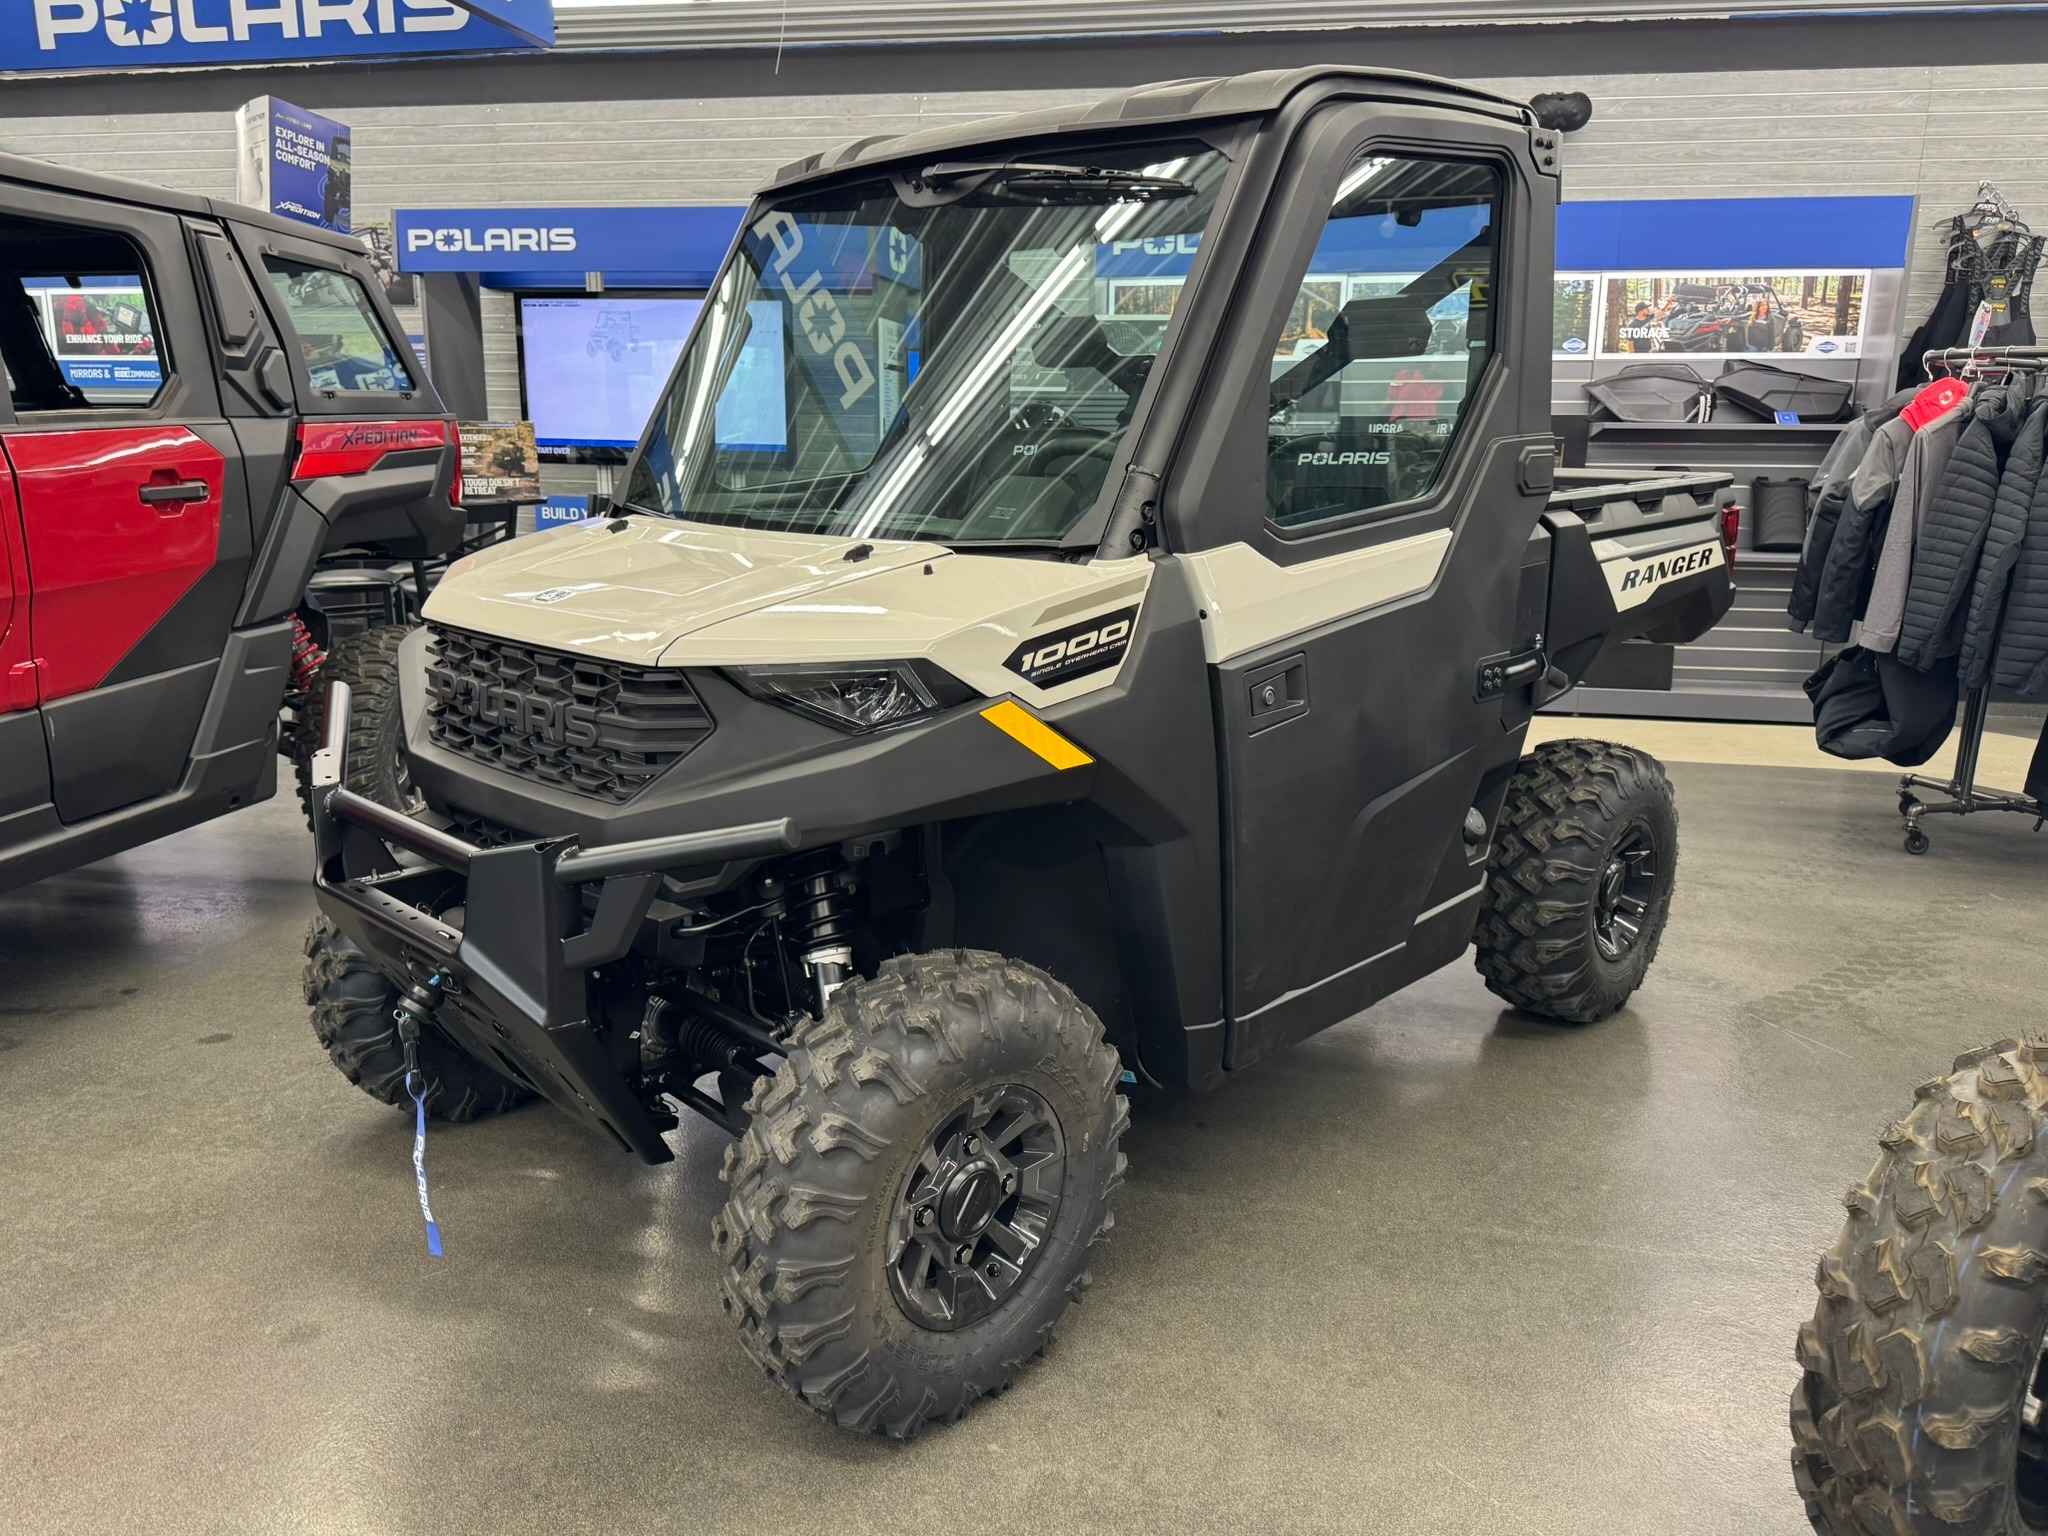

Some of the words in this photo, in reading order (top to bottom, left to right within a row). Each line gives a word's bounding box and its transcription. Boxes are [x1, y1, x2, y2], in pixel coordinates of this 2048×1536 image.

[38, 0, 470, 50] POLARIS
[275, 126, 315, 149] EXPLORE
[316, 140, 325, 152] IN
[275, 138, 331, 166] ALL-SEASON
[275, 149, 316, 172] COMFORT
[275, 201, 321, 220] XPEDITION
[407, 227, 577, 252] POLARIS
[66, 334, 103, 343] ENHANCE
[103, 334, 124, 343] YOUR
[125, 334, 143, 344] RIDE
[1619, 328, 1670, 339] STORAGE
[70, 368, 103, 379] MIRRORS
[104, 369, 110, 379] &
[341, 426, 418, 450] XPEDITION
[553, 447, 571, 455] OVER
[1297, 452, 1391, 466] POLARIS
[463, 478, 488, 487] TOUGH
[489, 478, 520, 487] DOESN'T
[464, 487, 497, 495] RETREAT
[541, 507, 579, 520] BUILD
[1620, 547, 1714, 592] RANGER
[1020, 619, 1130, 673] 1000
[1030, 662, 1062, 678] SINGLE
[1064, 645, 1108, 665] OVERHEAD
[1109, 639, 1128, 650] CAM
[436, 668, 599, 748] POLARIS
[413, 1134, 434, 1223] POLARIS
